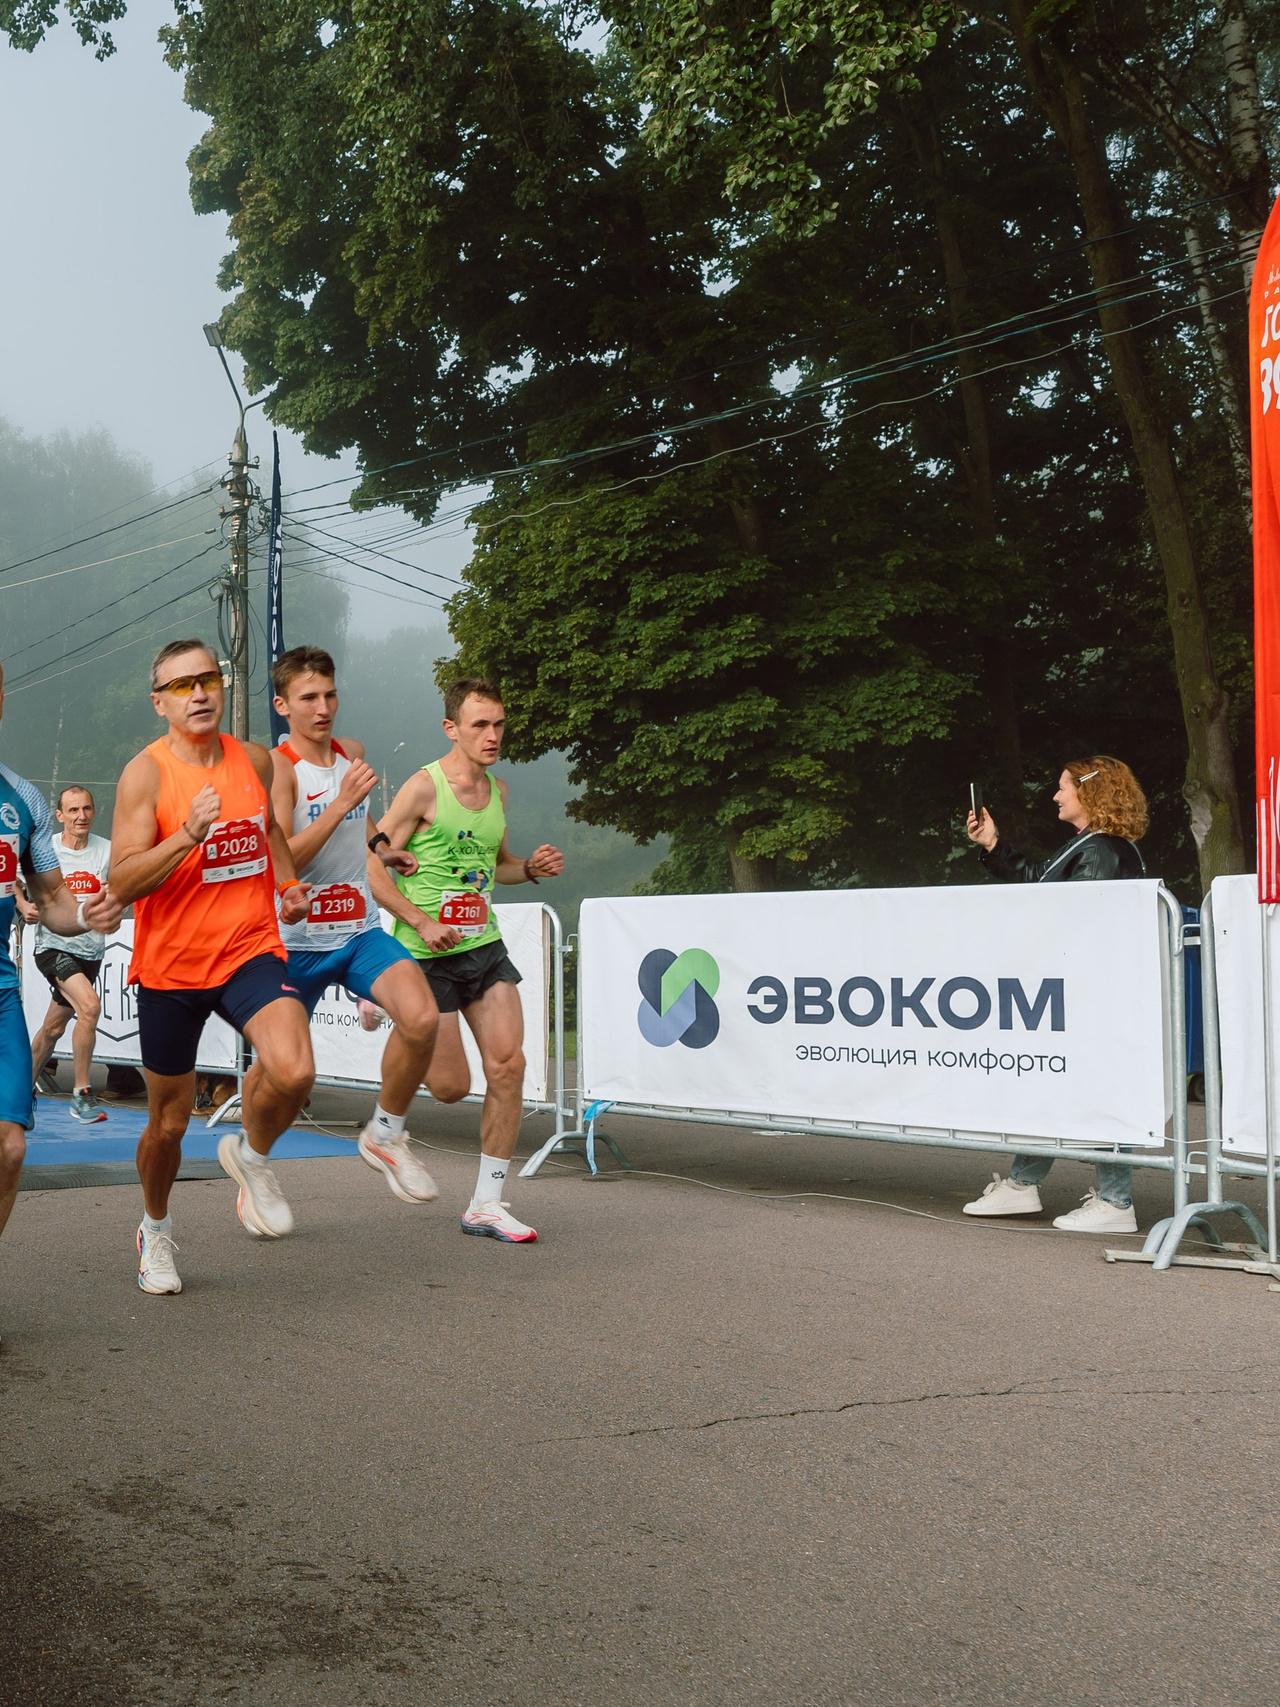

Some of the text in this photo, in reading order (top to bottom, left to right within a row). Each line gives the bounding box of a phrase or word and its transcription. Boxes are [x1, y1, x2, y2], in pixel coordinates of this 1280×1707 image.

[219, 835, 258, 857] 2028
[70, 880, 92, 890] 2014
[324, 898, 355, 914] 2319
[455, 905, 480, 918] 2161
[746, 975, 1066, 1032] ЭВОКОМ
[336, 1014, 395, 1030] комни
[795, 1044, 1066, 1077] эволюция комфорта
